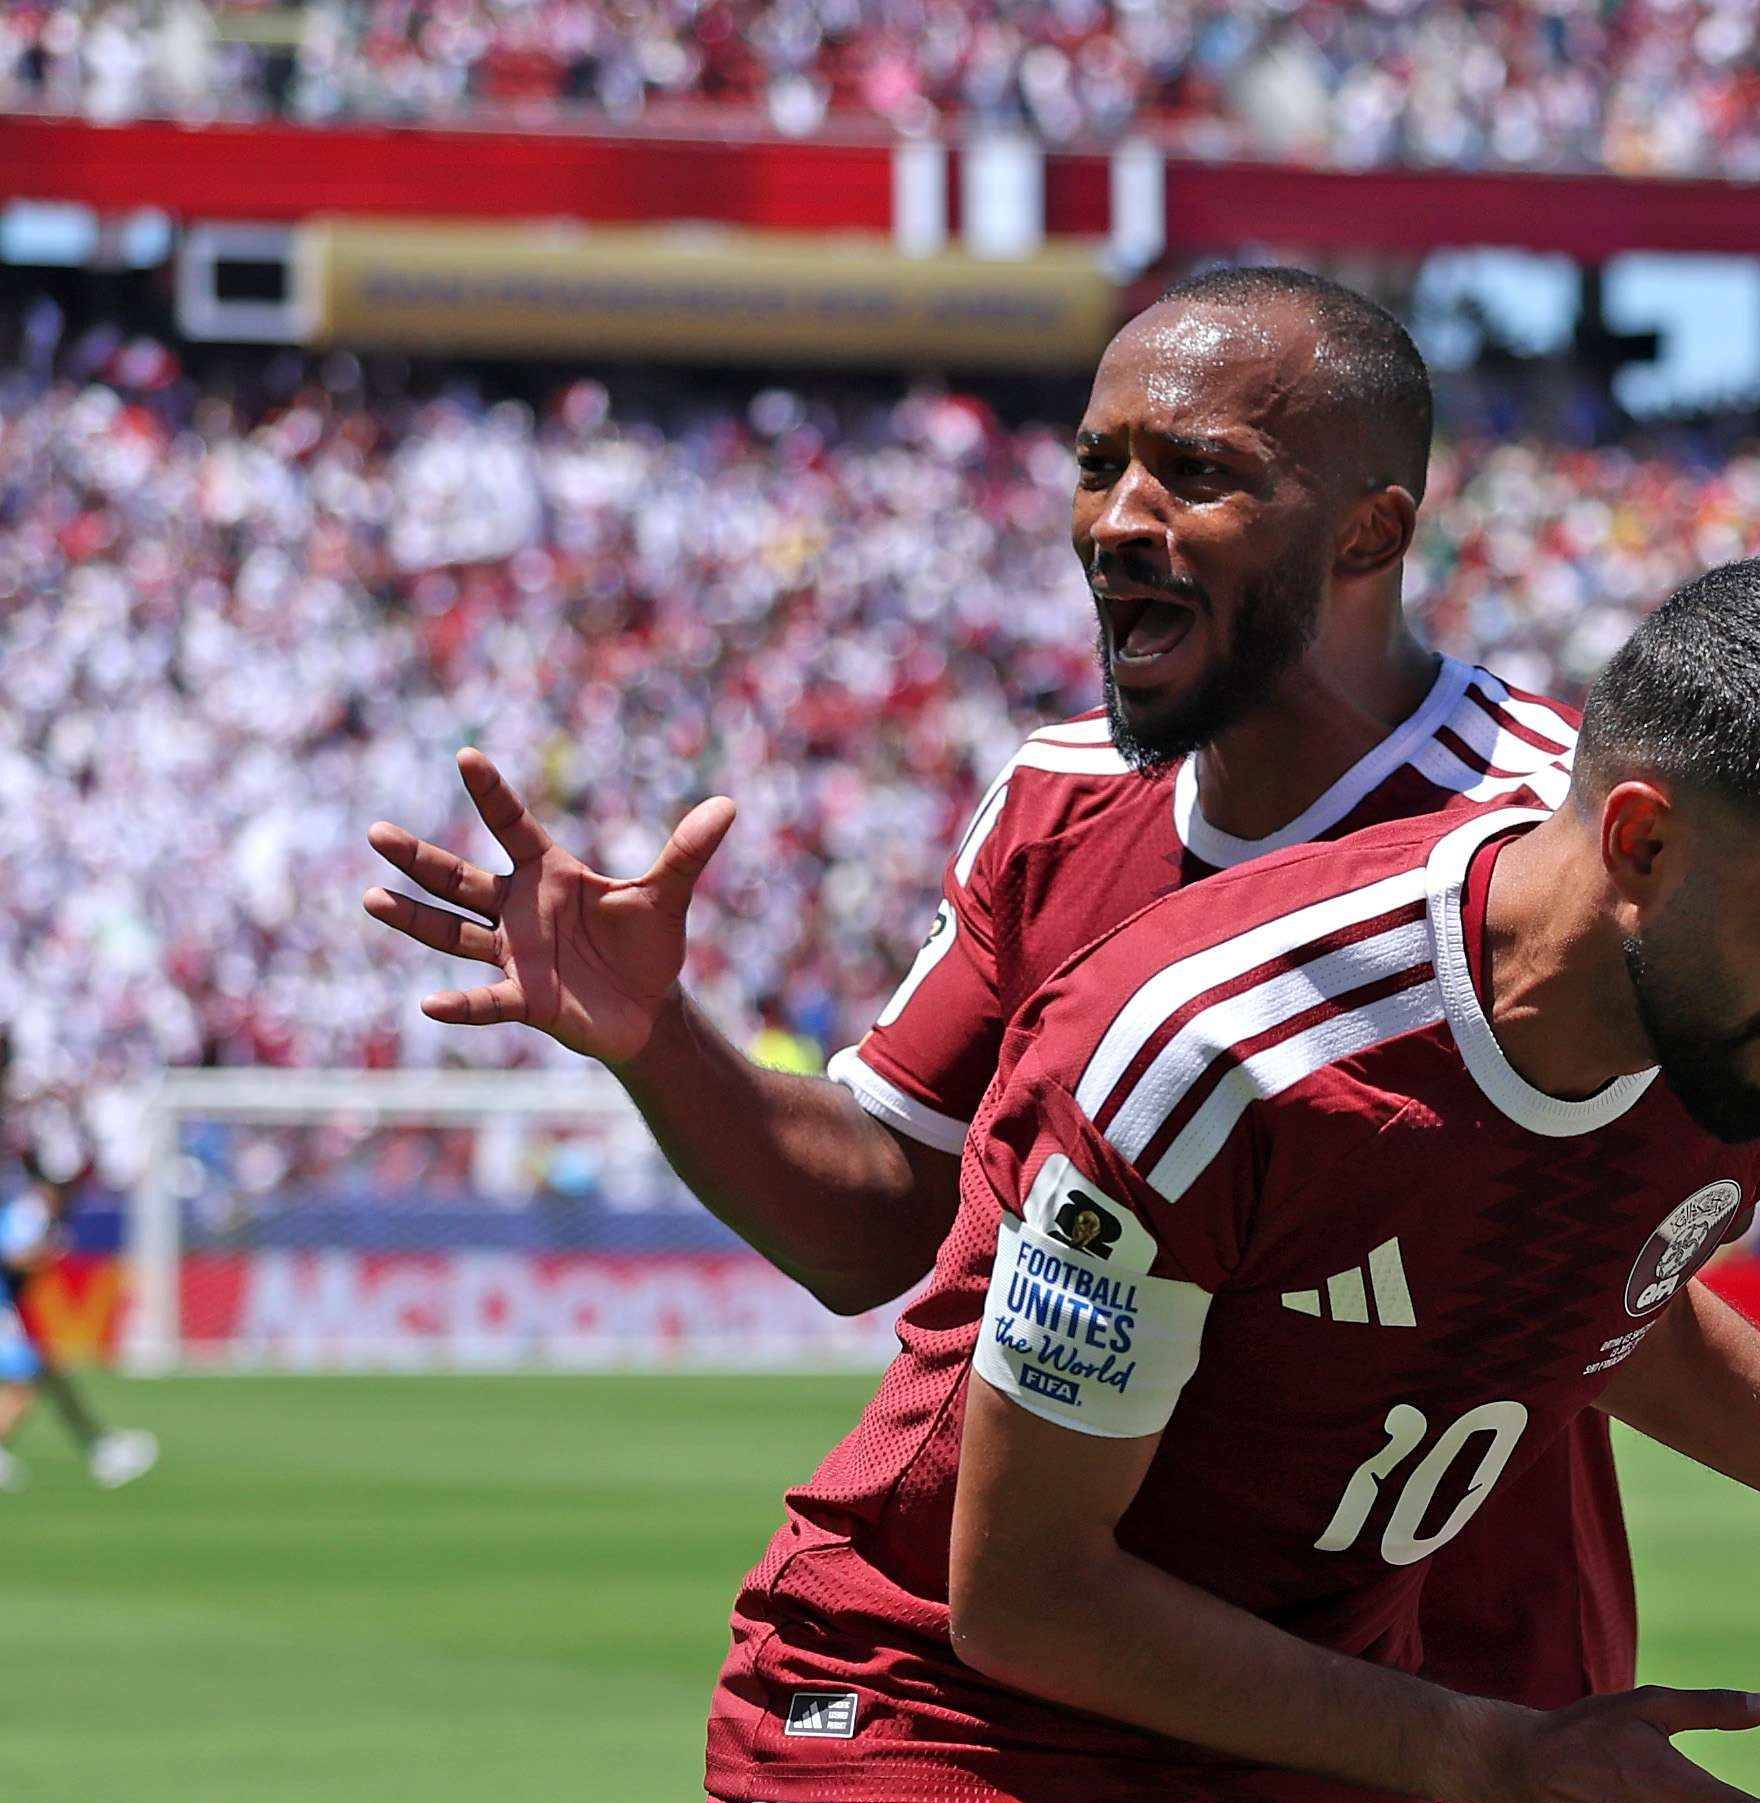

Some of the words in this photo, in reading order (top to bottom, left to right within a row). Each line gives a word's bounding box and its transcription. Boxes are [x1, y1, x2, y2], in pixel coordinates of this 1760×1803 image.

[1007, 1272, 1135, 1354] UNITES
[1017, 1242, 1138, 1314] FOOTBALL
[994, 1315, 1034, 1355] the
[1037, 1334, 1136, 1394] World
[1024, 1366, 1076, 1400] FIFA
[1314, 1401, 1528, 1565] 10
